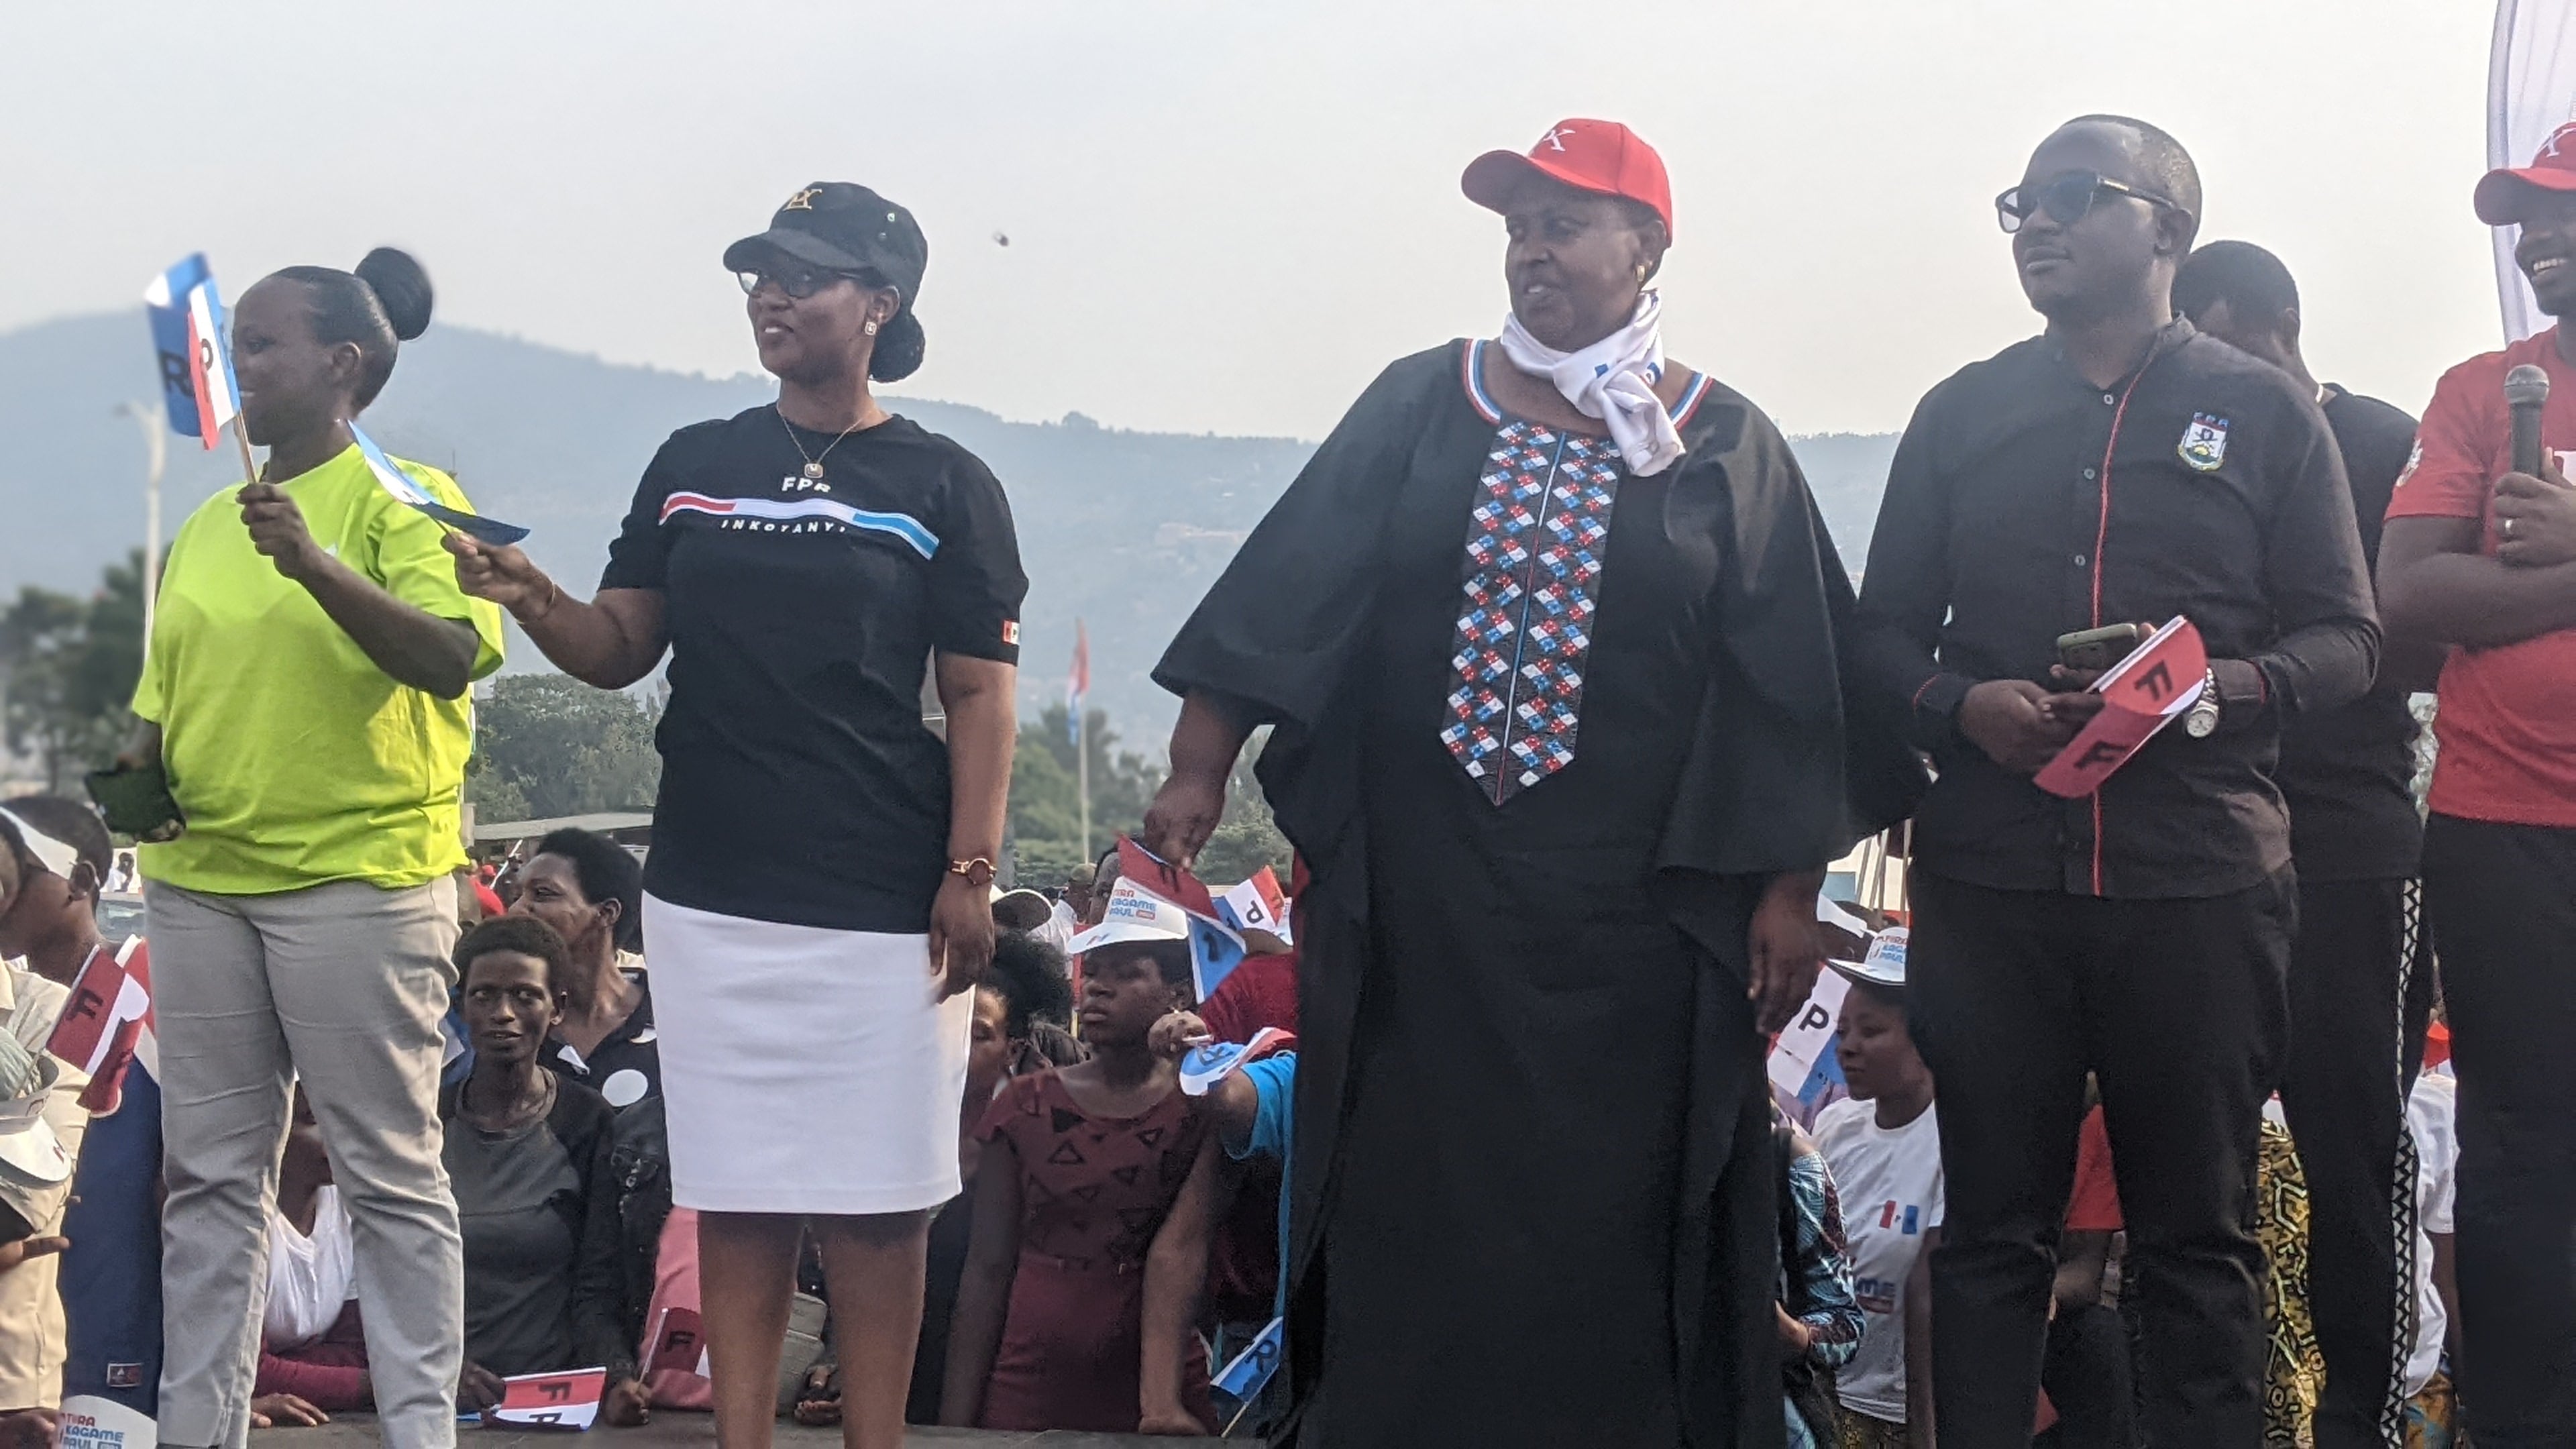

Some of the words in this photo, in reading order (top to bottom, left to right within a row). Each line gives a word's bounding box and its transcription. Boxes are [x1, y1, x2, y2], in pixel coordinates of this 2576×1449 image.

[781, 476, 832, 493] FPR
[2134, 659, 2173, 702] F
[1798, 1002, 1829, 1032] P
[538, 1382, 572, 1401] F
[66, 1425, 125, 1442] KAGAME
